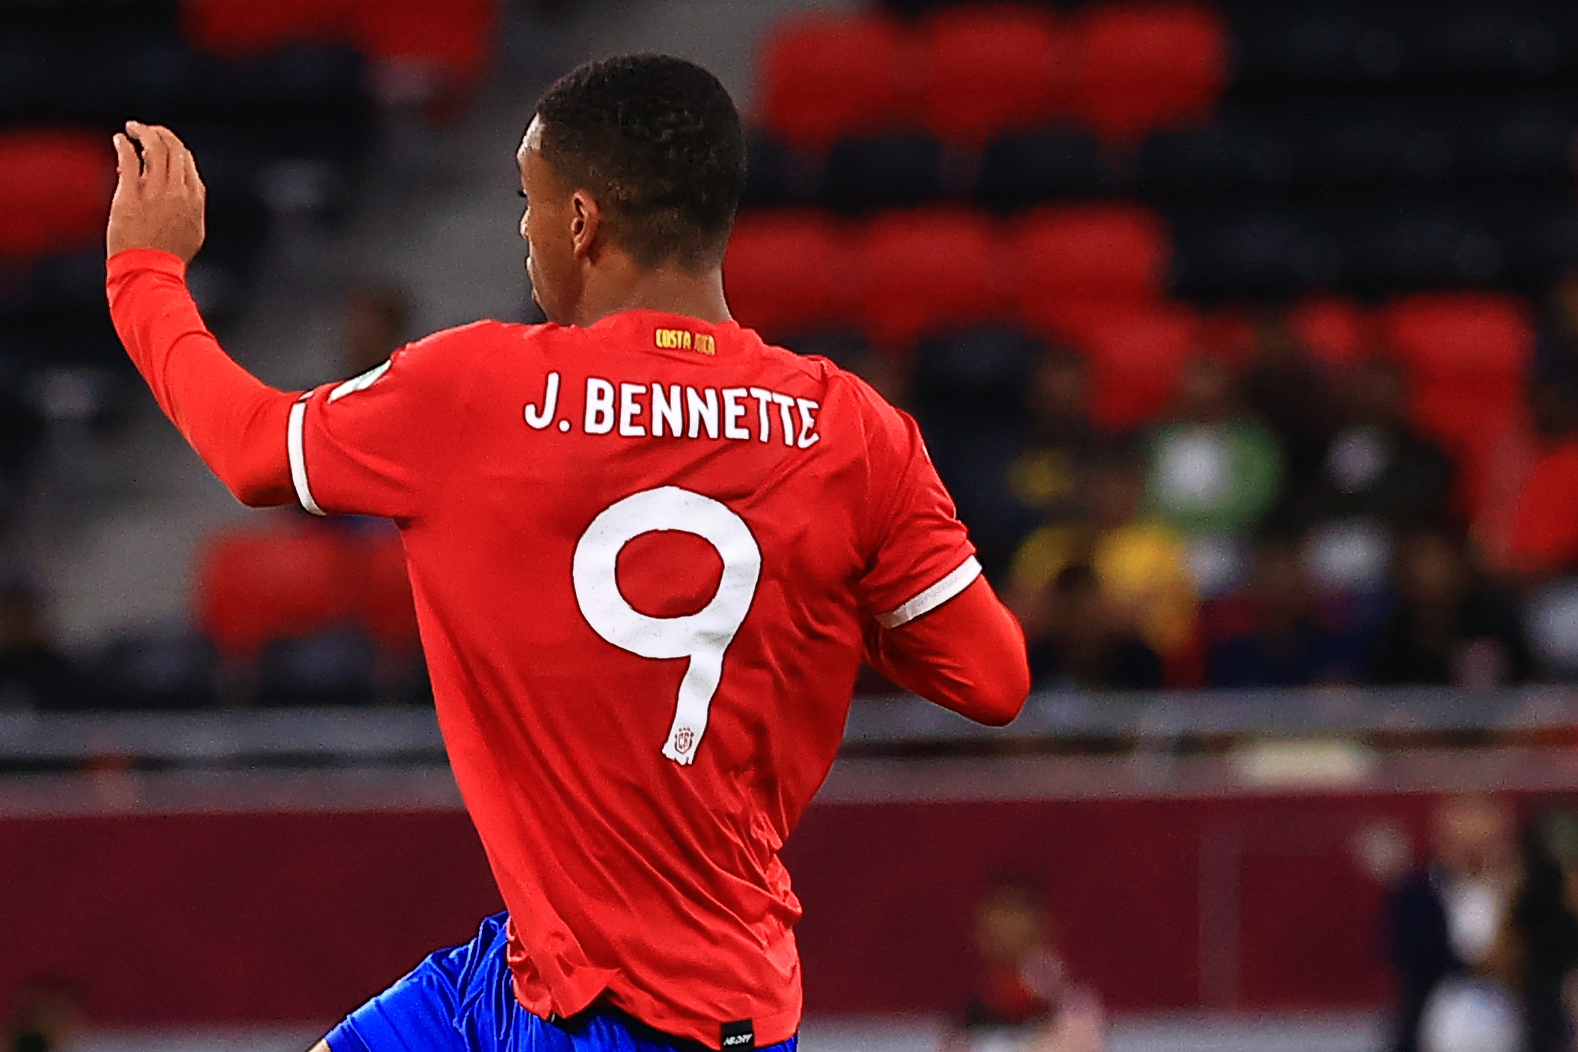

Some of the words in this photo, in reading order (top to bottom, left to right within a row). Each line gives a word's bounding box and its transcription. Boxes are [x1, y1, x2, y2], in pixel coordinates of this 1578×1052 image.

[655, 328, 692, 350] COSTA
[524, 371, 571, 432] J.
[583, 377, 820, 449] BENNETTE
[572, 485, 761, 766] 9
